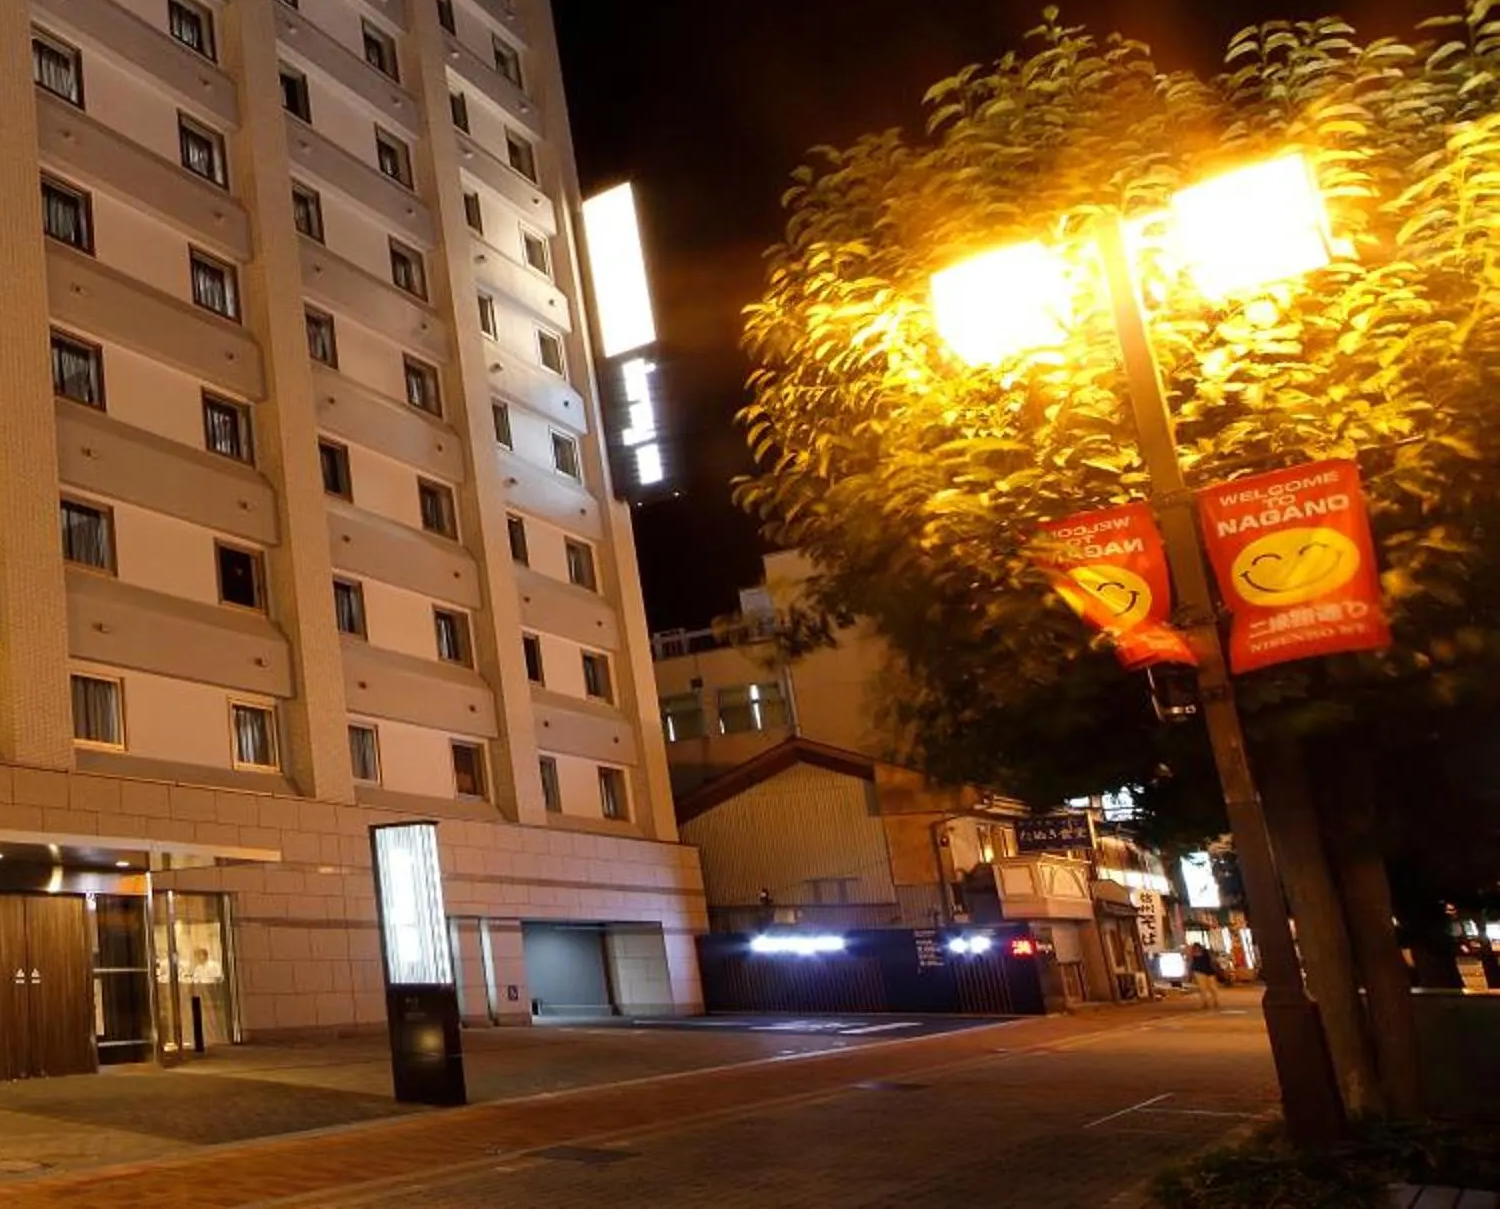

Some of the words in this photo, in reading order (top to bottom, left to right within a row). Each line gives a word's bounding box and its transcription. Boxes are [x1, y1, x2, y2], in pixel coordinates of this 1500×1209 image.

[1219, 471, 1340, 507] WELCOME
[1264, 494, 1297, 508] TO
[1216, 494, 1350, 538] NAGANO
